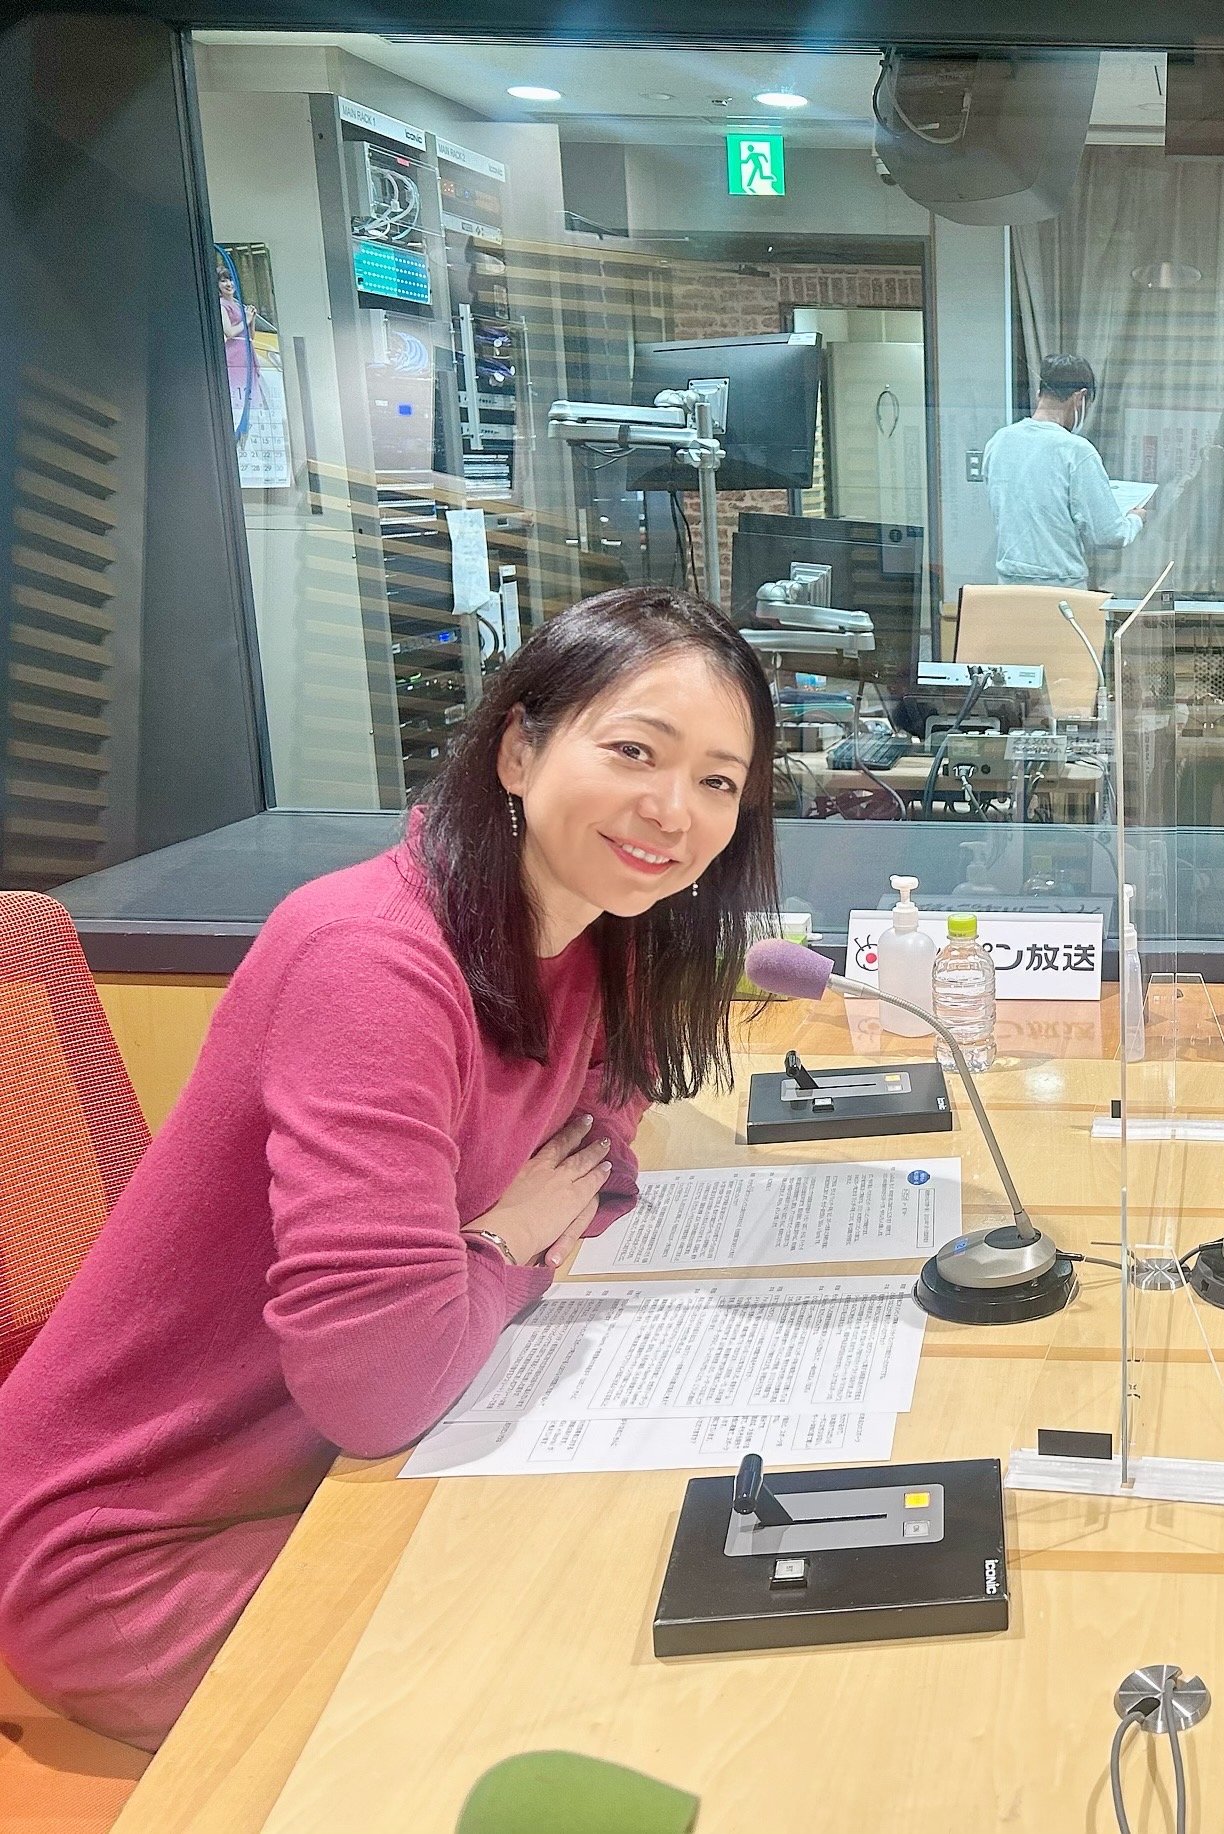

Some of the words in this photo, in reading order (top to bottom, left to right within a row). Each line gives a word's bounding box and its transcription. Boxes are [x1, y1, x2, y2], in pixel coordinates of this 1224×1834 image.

[342, 104, 357, 119] MAIN
[357, 109, 372, 124] RACK
[438, 143, 451, 156] MAIN
[451, 148, 462, 161] RACK
